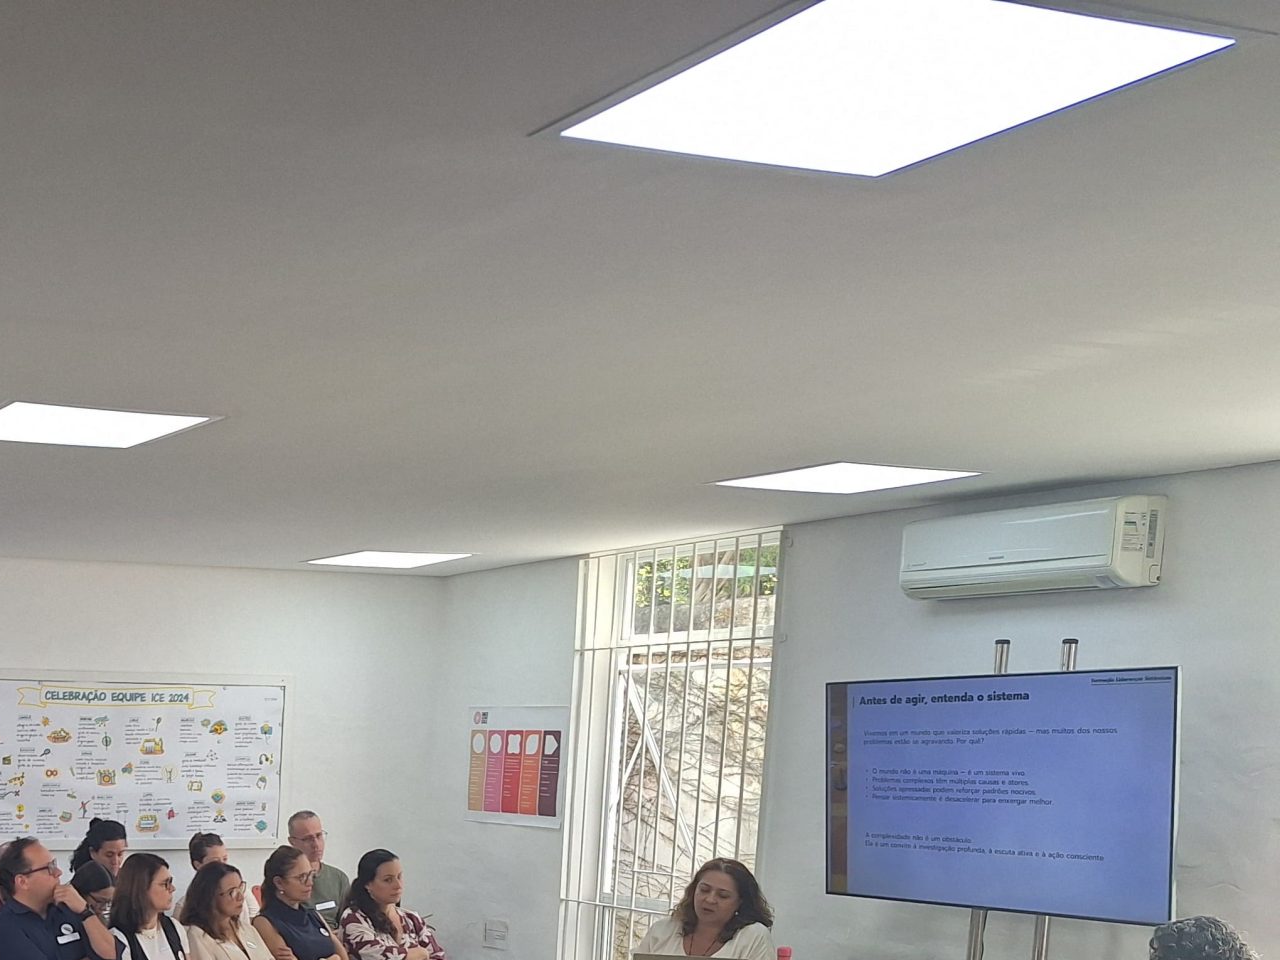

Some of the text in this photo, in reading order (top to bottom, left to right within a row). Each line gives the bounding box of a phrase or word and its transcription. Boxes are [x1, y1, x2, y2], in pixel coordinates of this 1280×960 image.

[44, 690, 189, 704] CELEBRAÇÃO EQUIPE ICE 2024
[859, 691, 1030, 706] Antes de agir, entenda o sistema
[972, 728, 1000, 737] soluções
[1001, 727, 1026, 736] rápidas
[1051, 727, 1075, 735] muitos
[1077, 727, 1091, 735] dos
[968, 737, 985, 745] quê?
[932, 769, 959, 777] máquina
[933, 786, 954, 794] podem
[956, 787, 980, 795] reforçar
[982, 787, 1009, 795] padrões
[998, 797, 1027, 806] enxergar
[1048, 852, 1065, 860] ação
